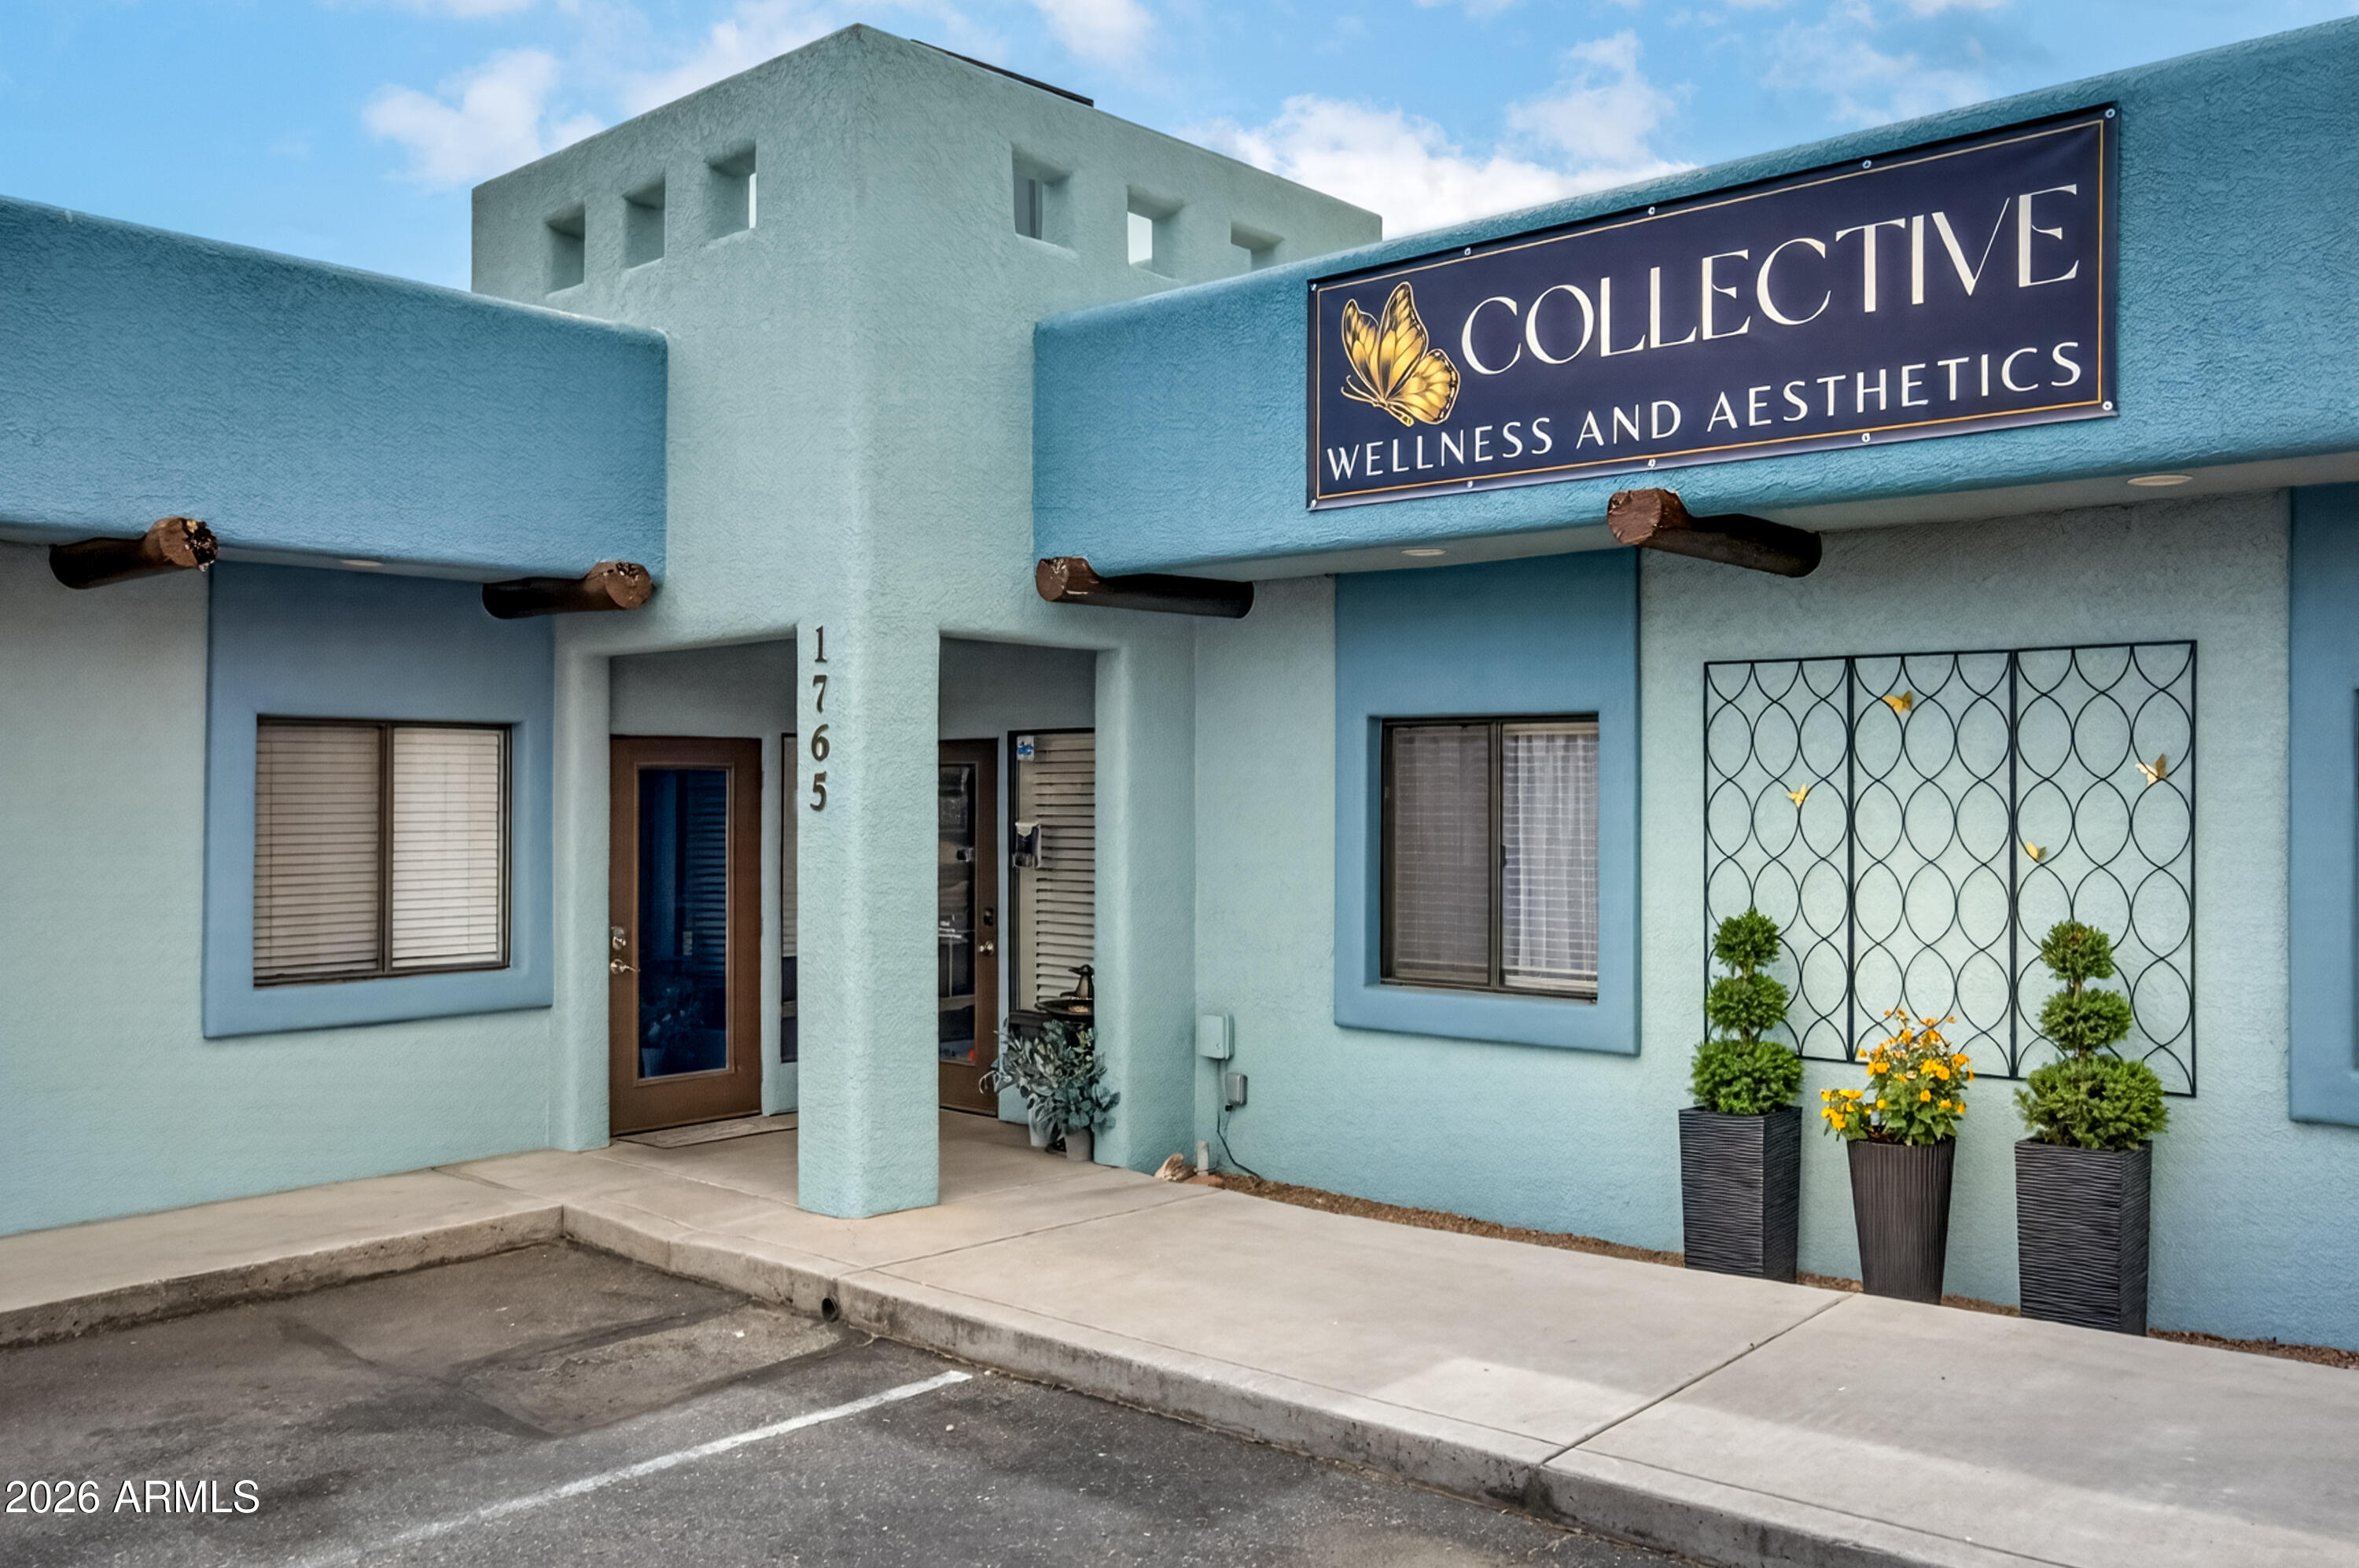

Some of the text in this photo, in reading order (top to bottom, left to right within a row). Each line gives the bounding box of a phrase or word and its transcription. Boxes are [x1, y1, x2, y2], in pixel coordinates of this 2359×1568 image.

[1461, 183, 2081, 376] COLLECTIVE
[1326, 340, 2083, 482] WELLNESS AND AESTHETICS
[809, 624, 830, 813] 1765
